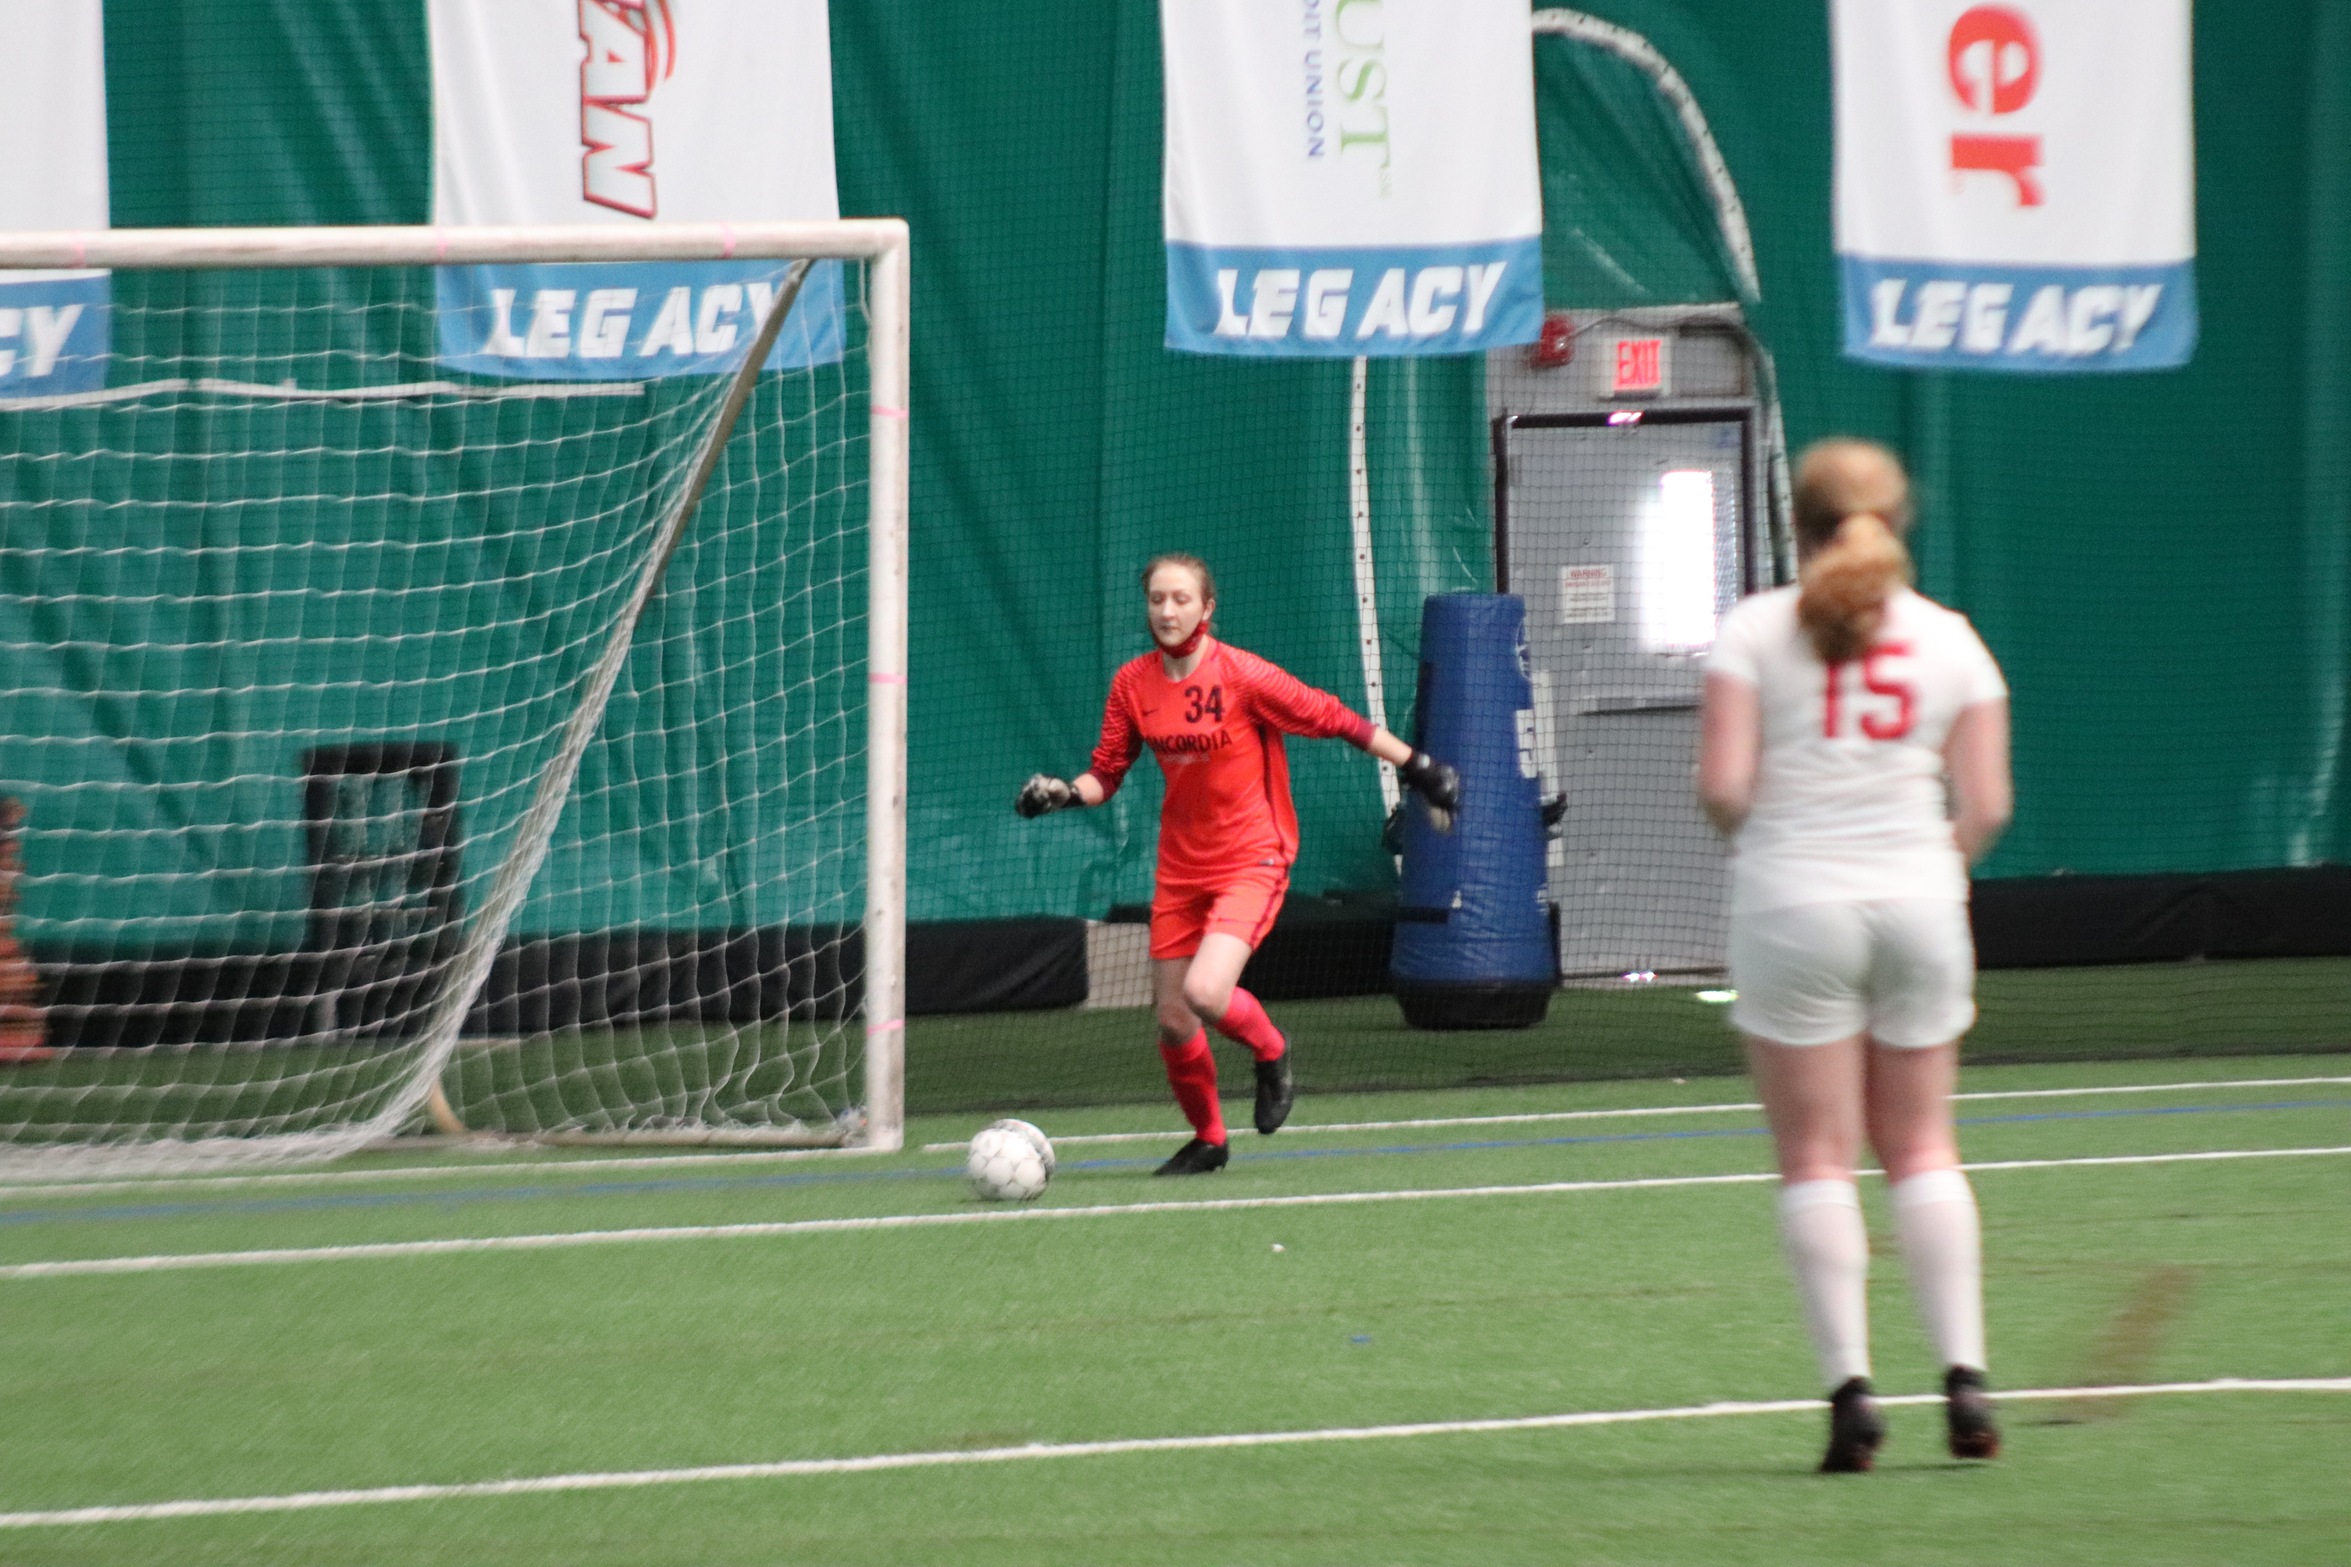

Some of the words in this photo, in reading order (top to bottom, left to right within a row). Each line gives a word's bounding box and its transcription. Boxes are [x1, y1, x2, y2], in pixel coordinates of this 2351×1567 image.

[578, 0, 658, 220] AN
[1305, 48, 1325, 158] UNION
[1212, 261, 1507, 338] LEGACY
[1869, 277, 2165, 355] LEGACY
[1616, 339, 1662, 387] EXIT
[1184, 684, 1225, 724] 34
[1823, 640, 1920, 740] 15
